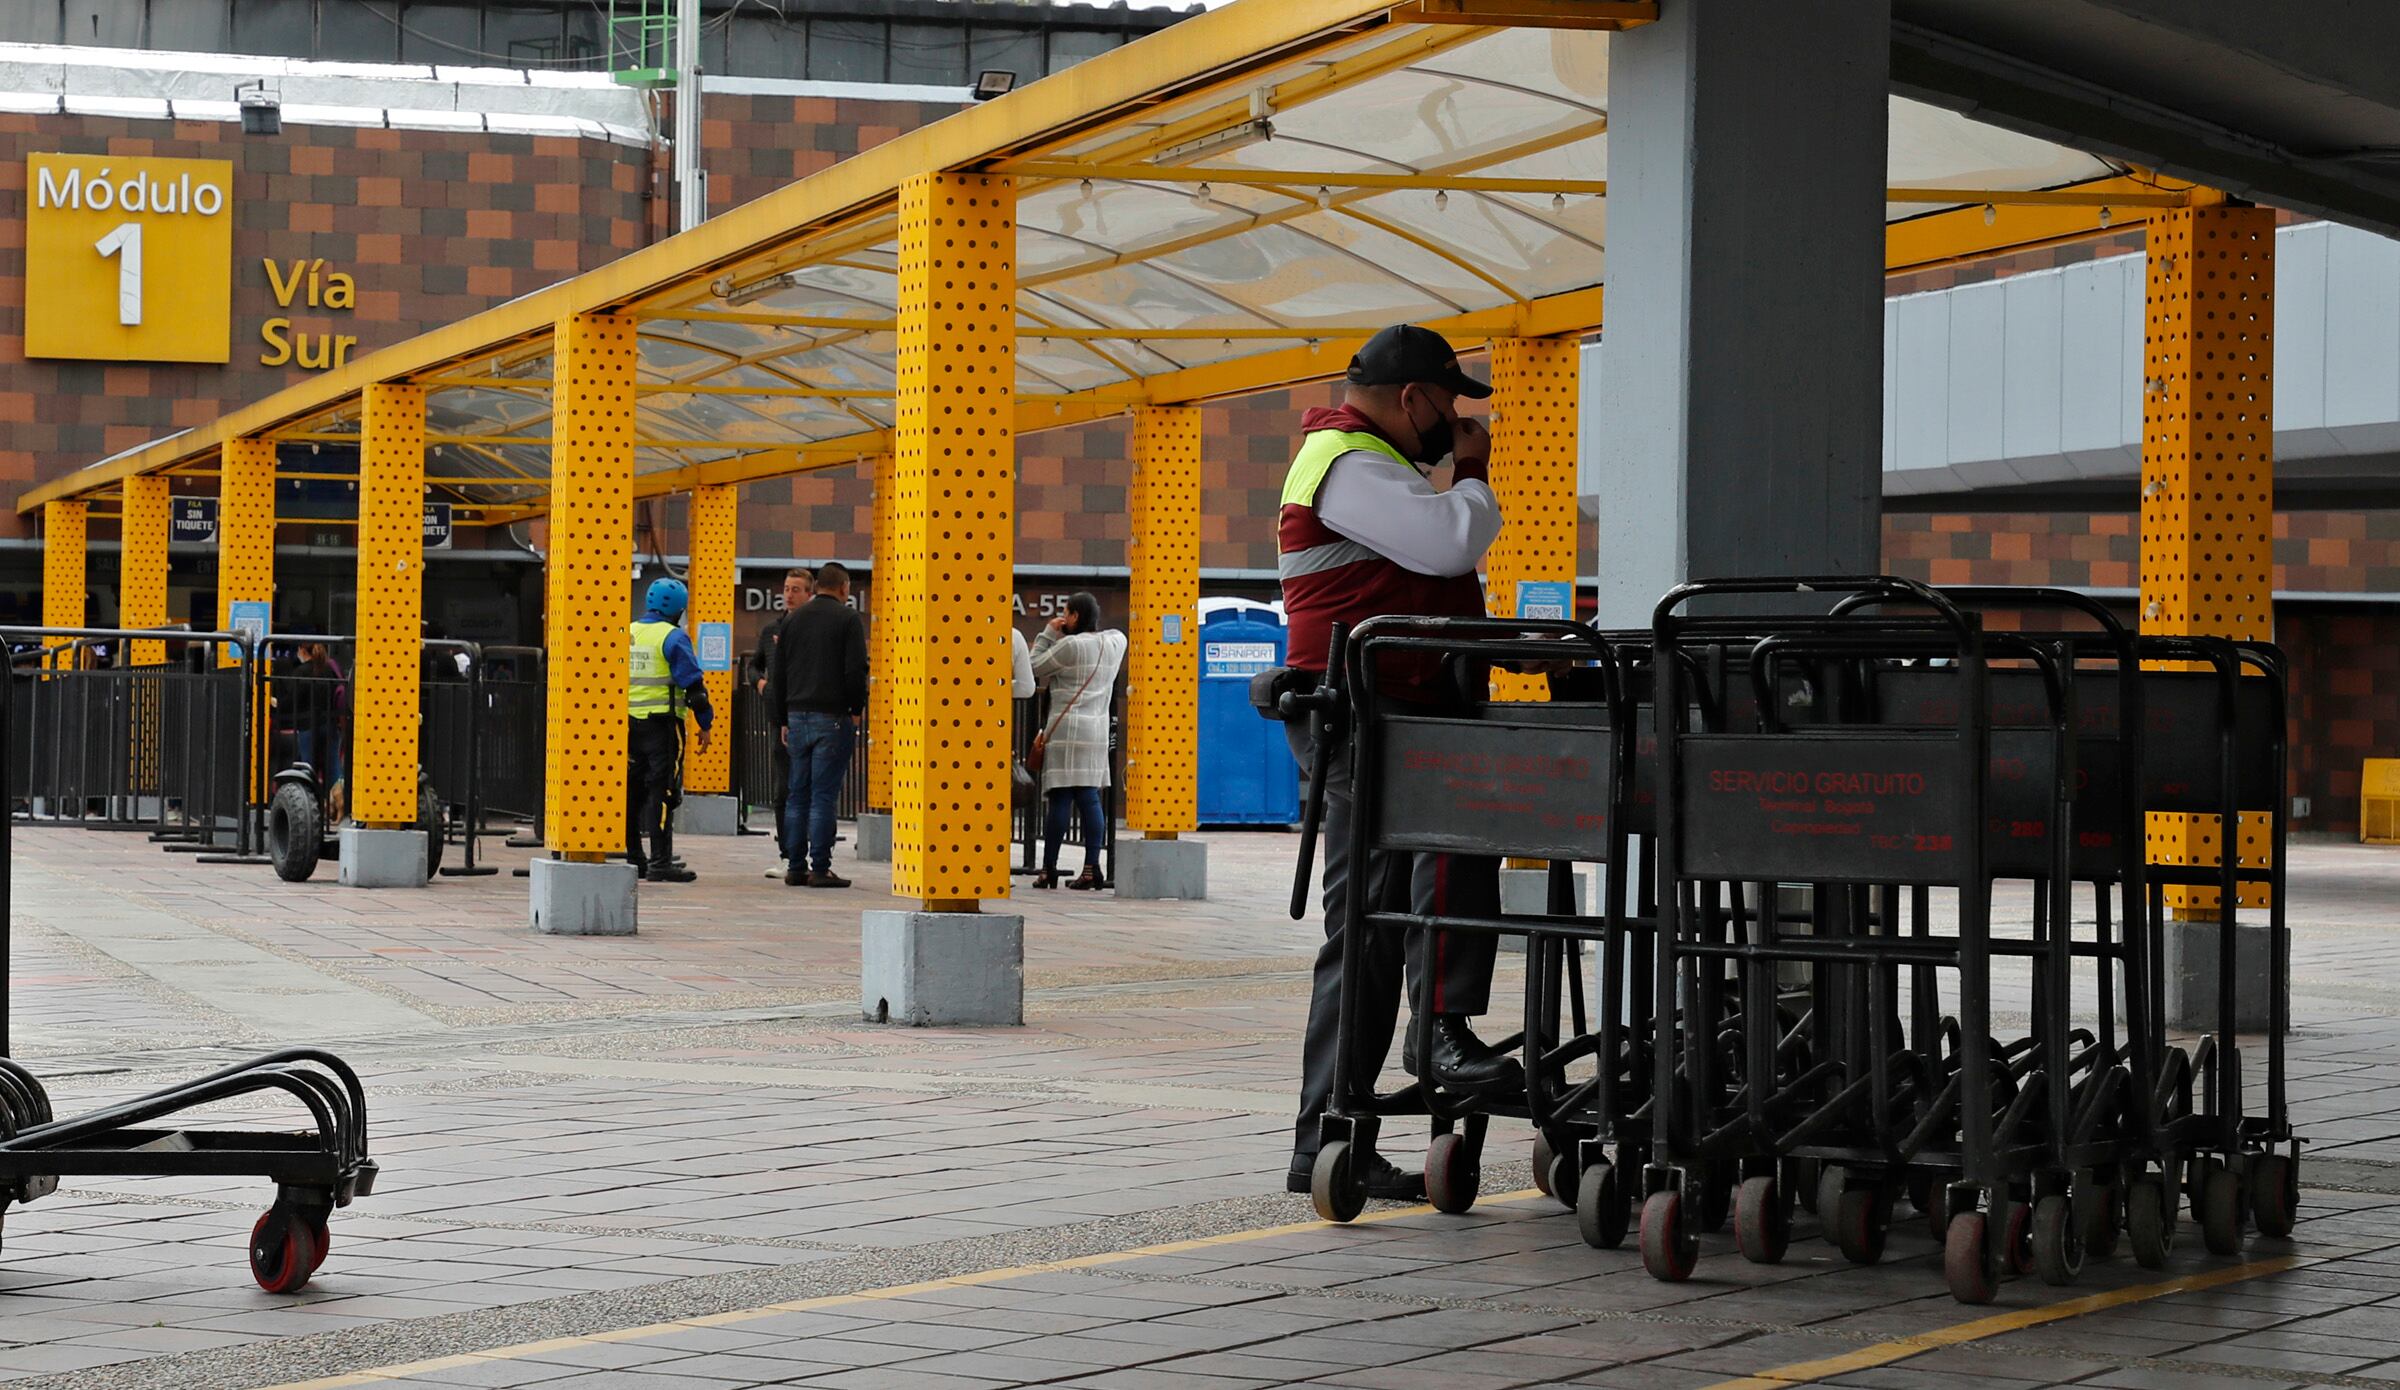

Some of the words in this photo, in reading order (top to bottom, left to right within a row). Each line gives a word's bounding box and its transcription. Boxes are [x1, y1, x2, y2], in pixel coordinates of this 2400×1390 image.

[37, 165, 224, 217] Módulo
[93, 222, 143, 327] 1
[262, 256, 356, 310] Vía
[260, 317, 357, 370] Sur
[175, 520, 214, 531] TIQUETE
[186, 509, 203, 519] SIN
[423, 525, 447, 536] UETE
[745, 587, 865, 613] Diaal
[1011, 593, 1070, 617] A-55
[1220, 648, 1273, 658] SANIPORT
[1709, 769, 1810, 795] SERVICIO
[1815, 771, 1926, 796] GRATUITO
